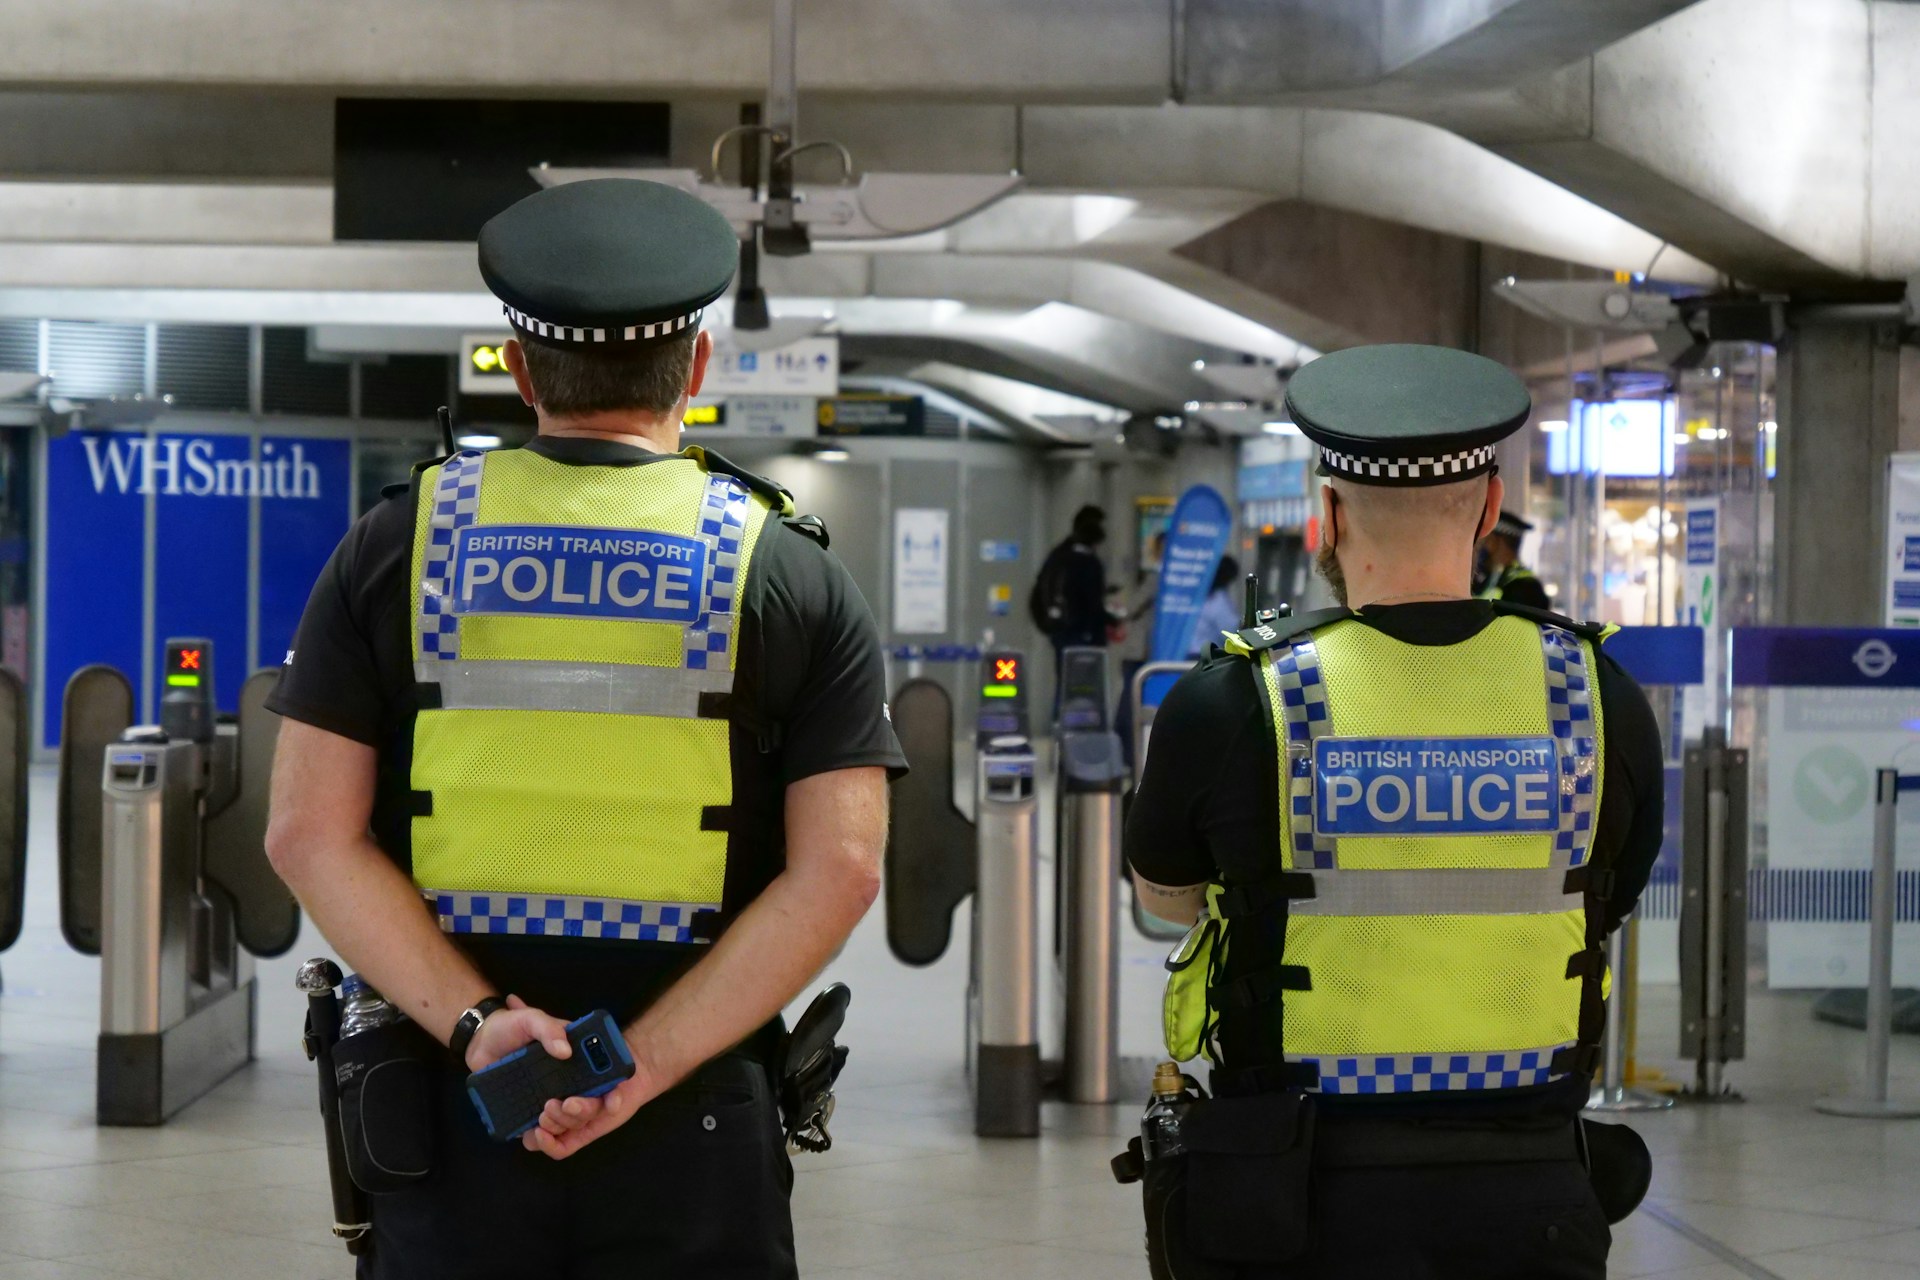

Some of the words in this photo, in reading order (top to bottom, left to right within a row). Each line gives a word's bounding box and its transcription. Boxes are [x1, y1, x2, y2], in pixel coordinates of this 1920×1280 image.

[81, 436, 321, 498] WHSmith
[467, 535, 552, 552] BRITISH
[559, 536, 695, 562] TRANSPORT
[461, 556, 692, 610] POLICE
[1326, 751, 1412, 769] BRITISH
[1418, 749, 1548, 769] TRANSPORT
[1326, 773, 1550, 823] POLICE
